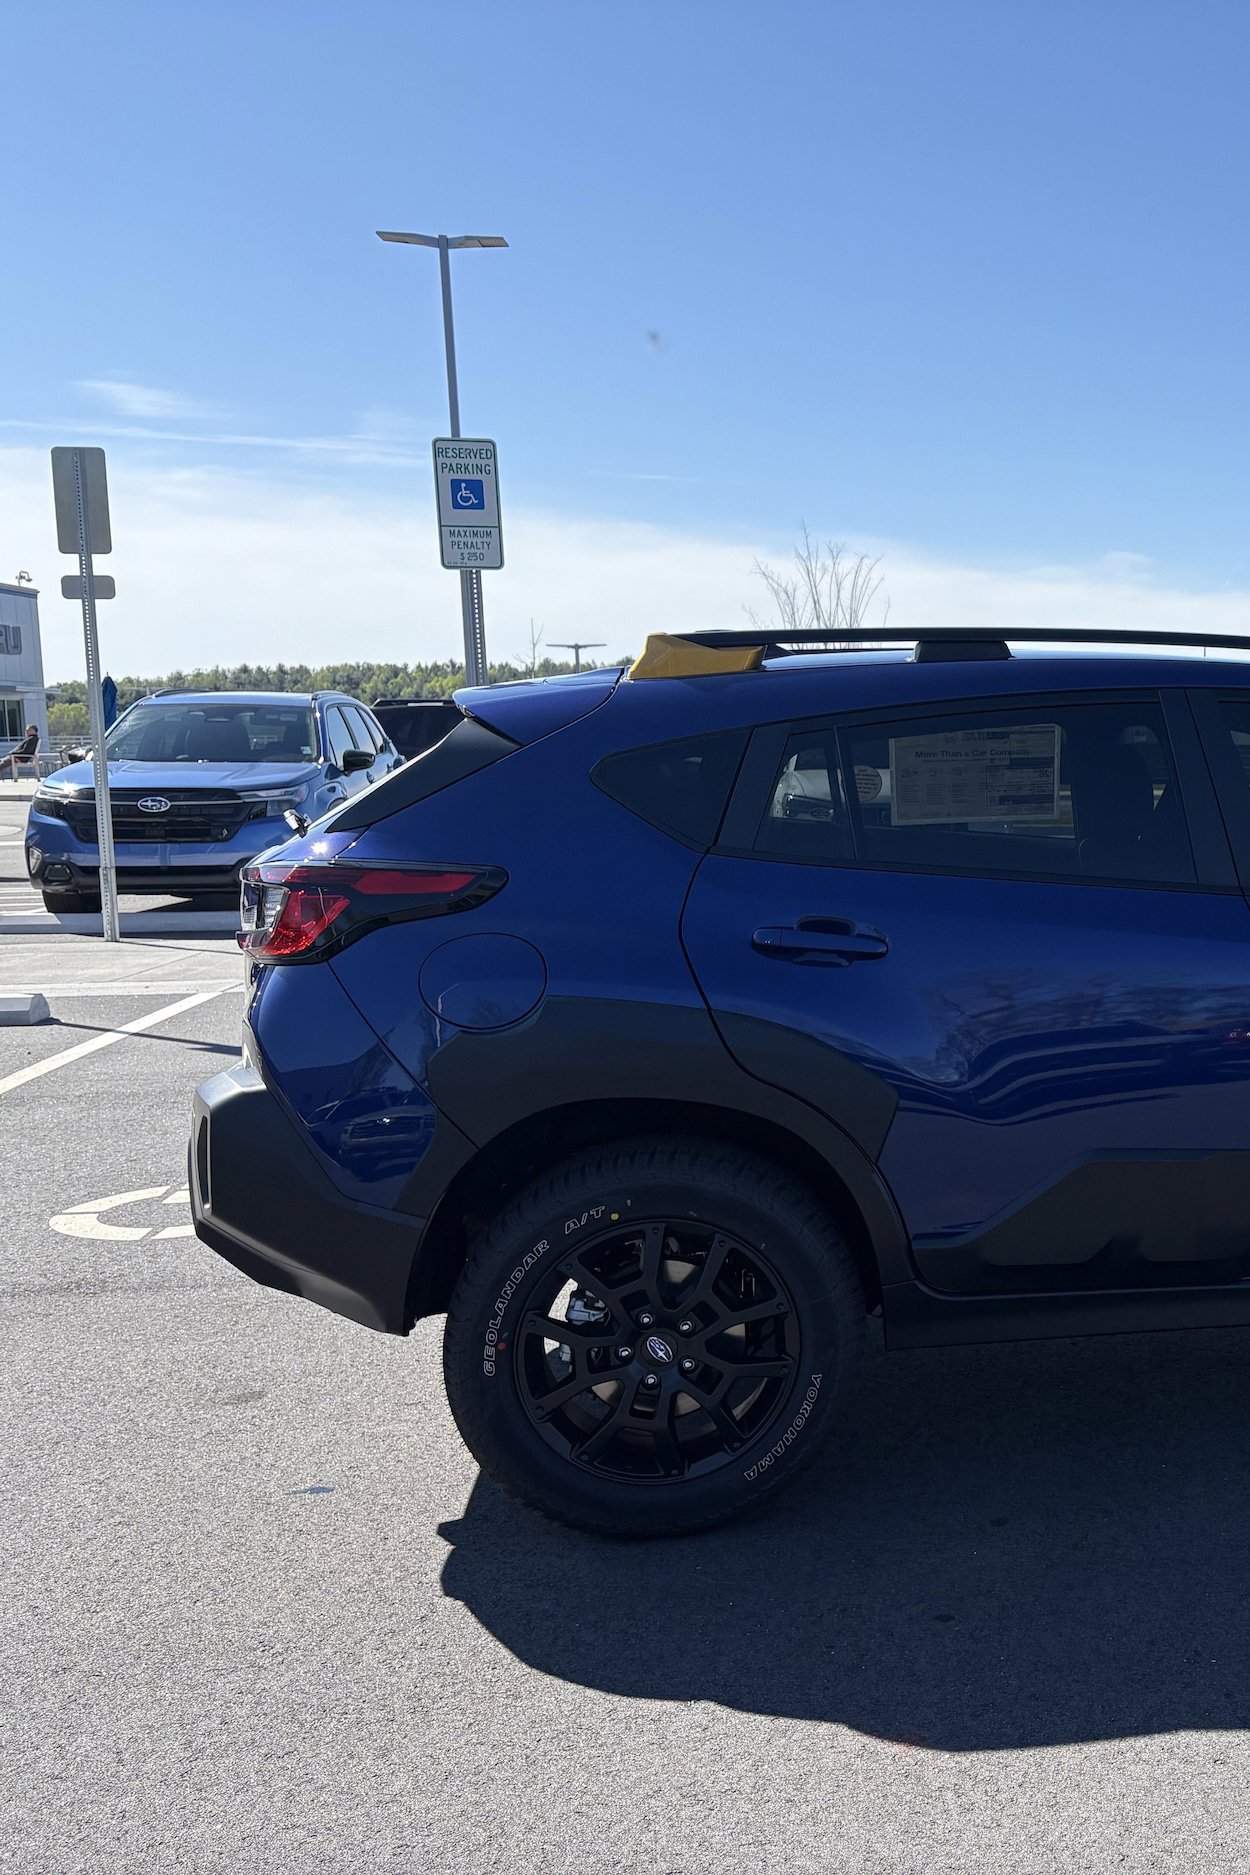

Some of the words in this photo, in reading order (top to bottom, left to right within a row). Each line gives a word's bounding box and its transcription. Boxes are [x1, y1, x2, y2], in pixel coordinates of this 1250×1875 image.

[437, 447, 493, 460] RESERVED
[441, 463, 491, 475] PARKING
[449, 529, 492, 538] MAXIMUM
[451, 540, 491, 550] PENALTY
[915, 751, 937, 759] More
[989, 749, 1030, 757] Company
[483, 1239, 550, 1377] GEOLANDAR
[565, 1205, 606, 1234] A/T
[743, 1373, 823, 1481] YOKOHAMA
